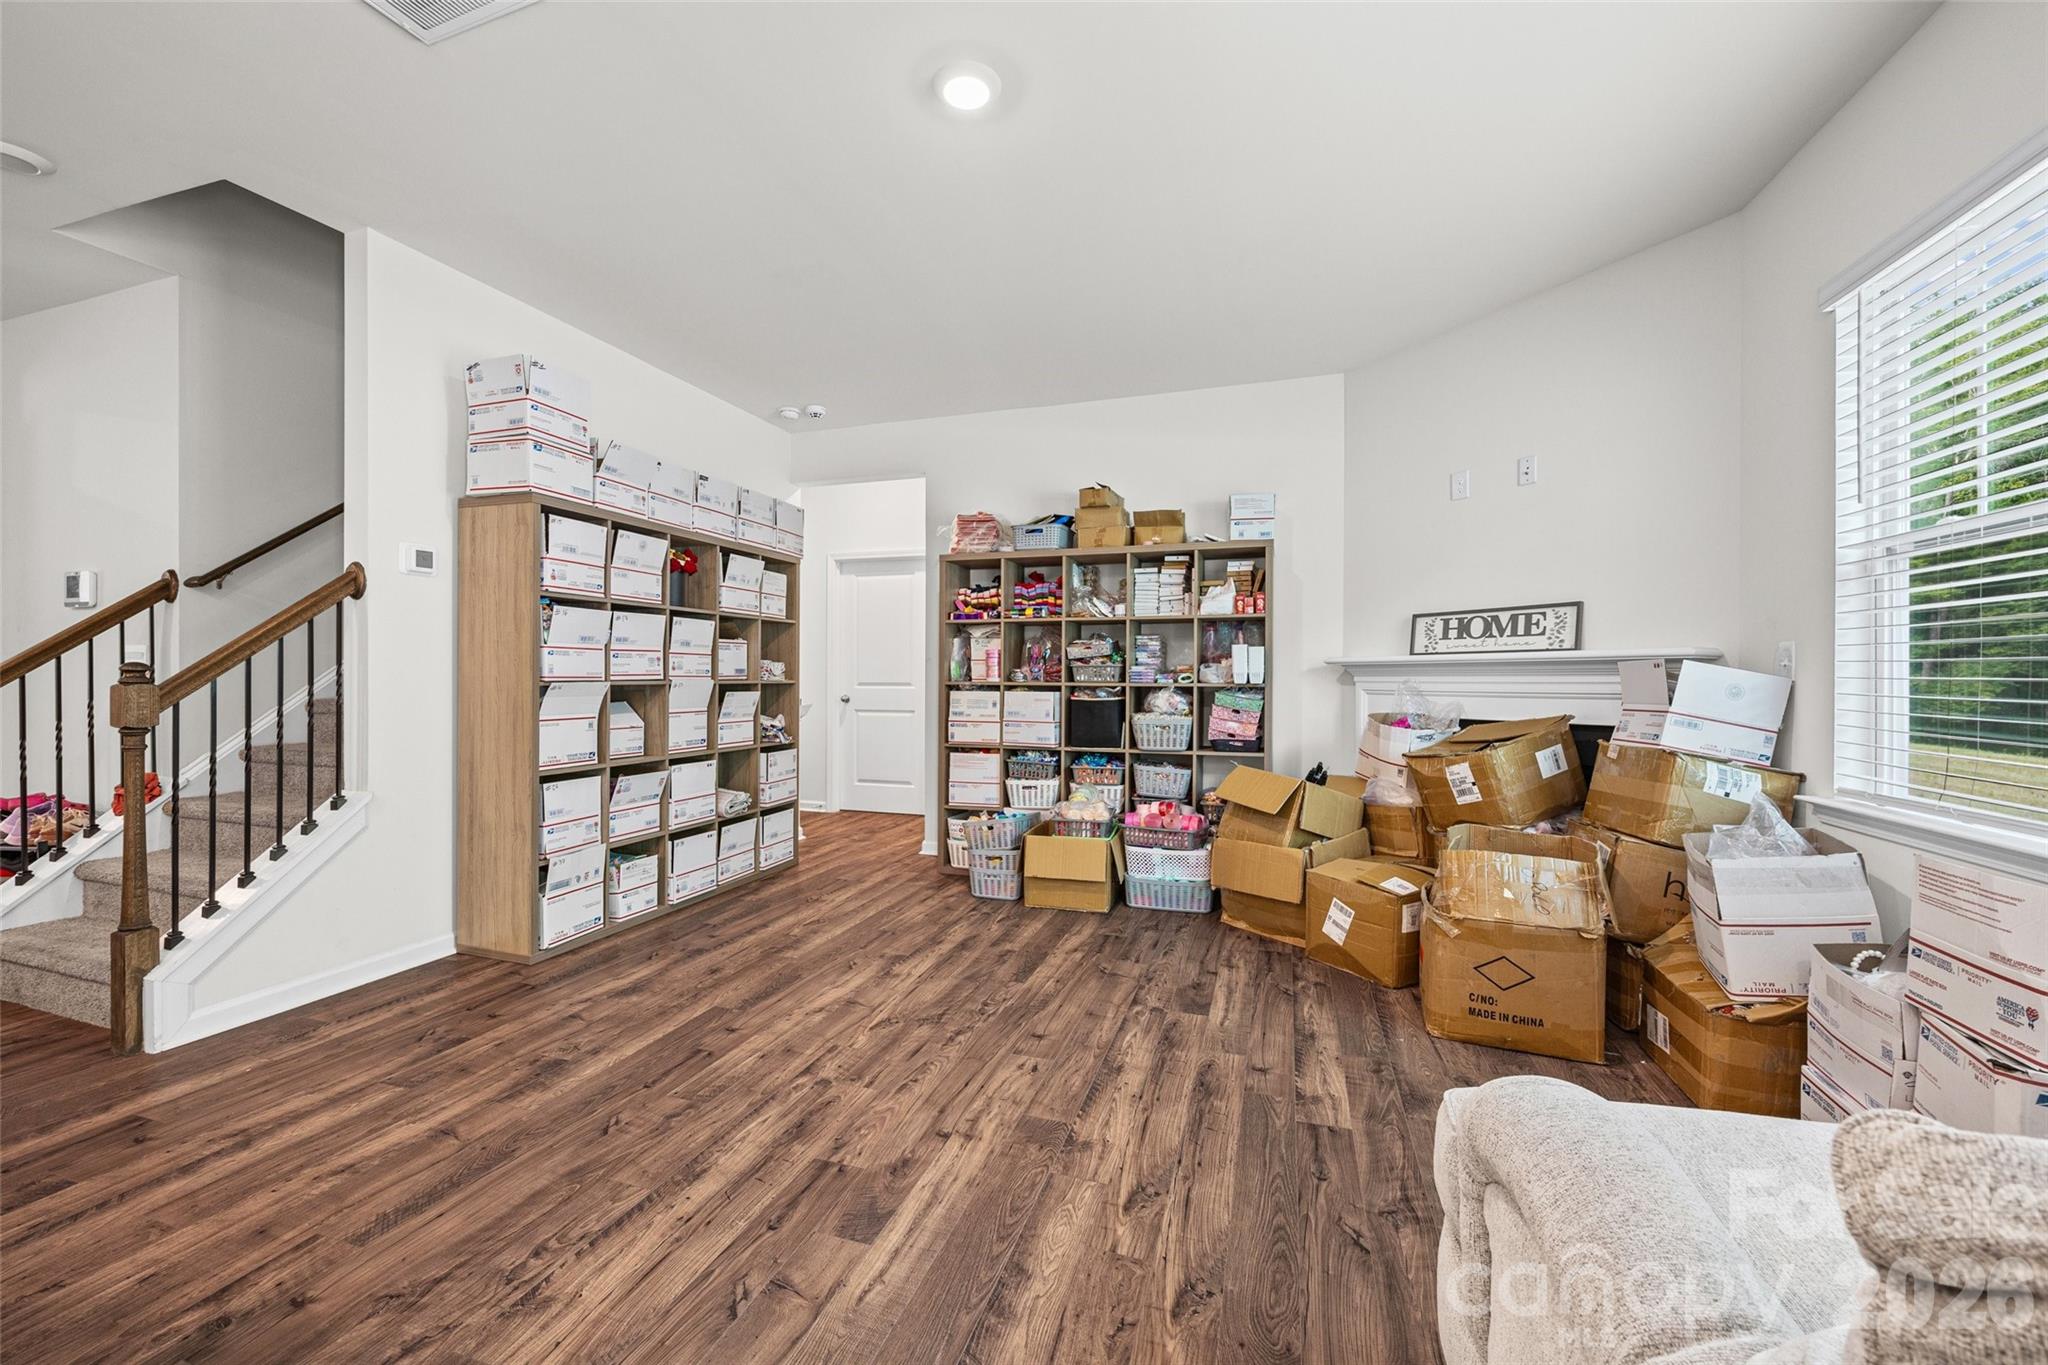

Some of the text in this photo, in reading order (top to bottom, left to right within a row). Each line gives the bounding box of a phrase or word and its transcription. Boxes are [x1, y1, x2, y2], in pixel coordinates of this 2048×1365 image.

[1439, 612, 1547, 640] HOME
[1967, 977, 1982, 987] MAIL
[1468, 992, 1498, 1006] C/NO:
[1997, 996, 2024, 1011] AMERICA
[1996, 1002, 2025, 1017] SUPPORTS
[2003, 1008, 2017, 1019] YOU
[1468, 1007, 1544, 1028] MADE IN CHINA
[1968, 1059, 2000, 1085] PRIORITY
[1974, 1074, 1990, 1089] MAIL
